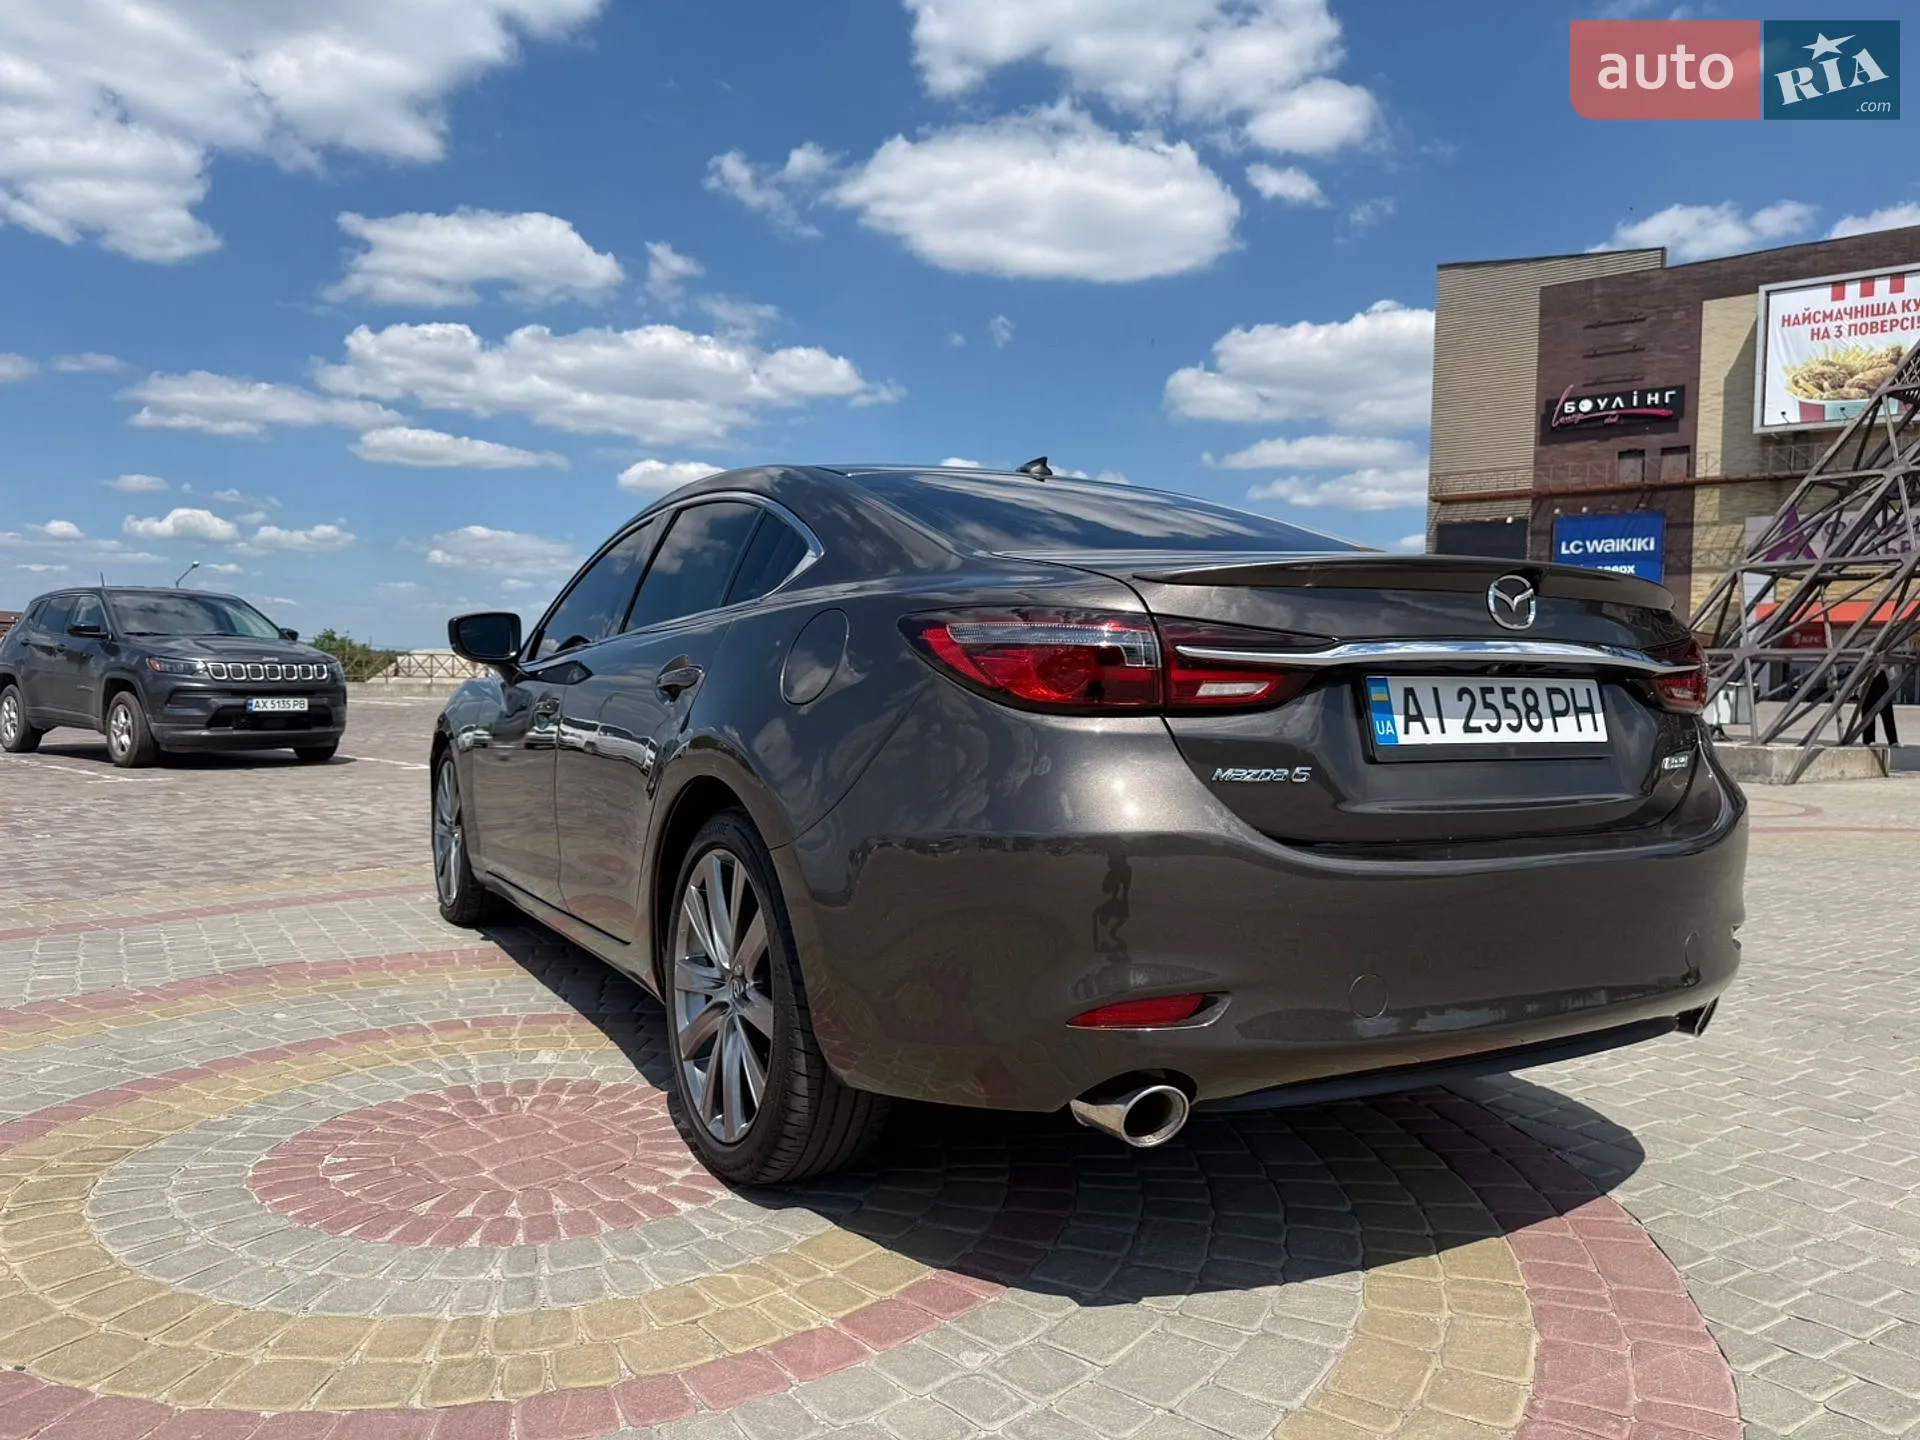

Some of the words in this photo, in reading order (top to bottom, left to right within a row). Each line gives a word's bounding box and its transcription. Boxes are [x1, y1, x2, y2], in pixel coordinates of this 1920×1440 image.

[1781, 301, 1898, 328] НАЙСМАЧНІША
[1810, 326, 1831, 342] НА
[1834, 324, 1843, 339] 3
[1560, 540, 1584, 555] LC
[1402, 686, 1447, 735] AI
[1456, 686, 1544, 734] 2558
[1545, 687, 1599, 733] PH
[1374, 718, 1395, 736] UA
